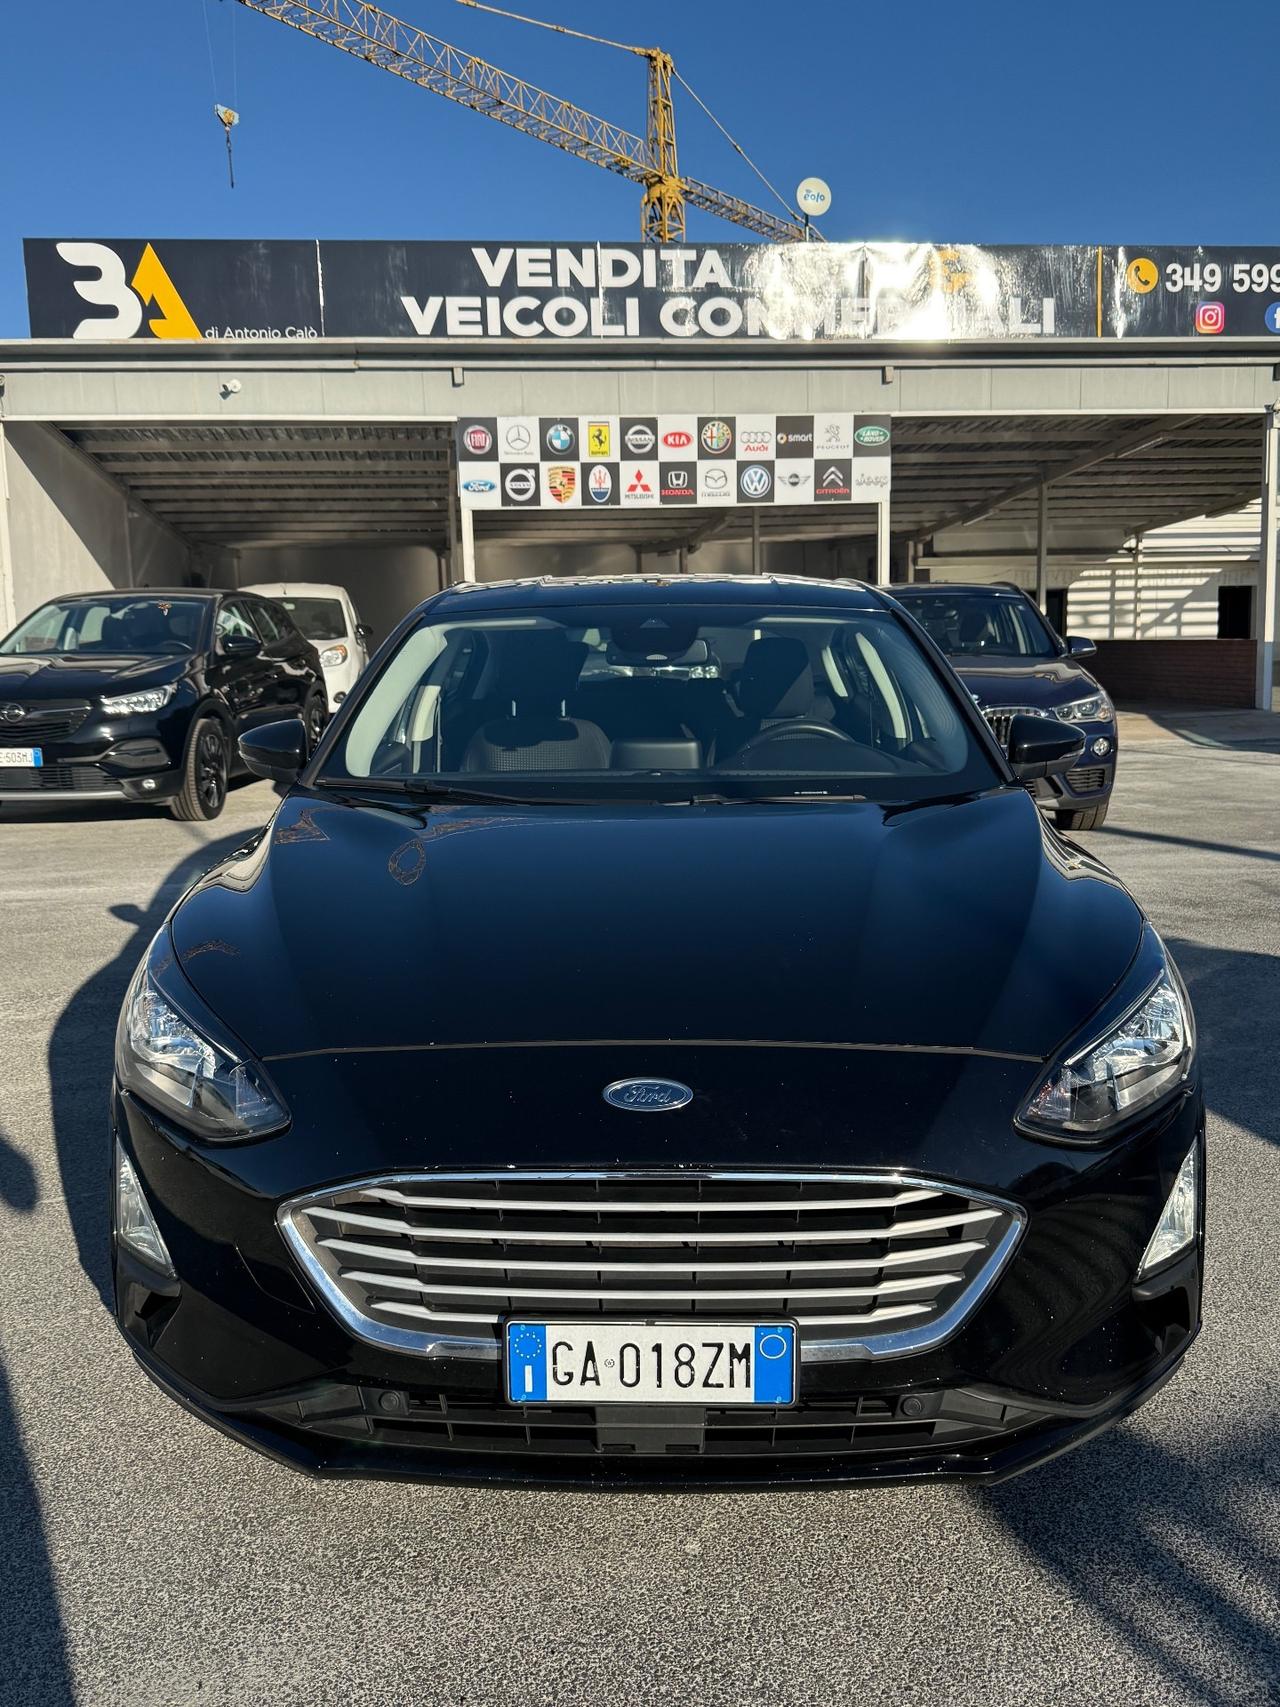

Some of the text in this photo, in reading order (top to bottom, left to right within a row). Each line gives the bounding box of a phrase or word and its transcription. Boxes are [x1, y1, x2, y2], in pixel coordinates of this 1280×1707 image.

[471, 247, 732, 289] VENDITA
[1165, 262, 1222, 293] 349
[401, 295, 640, 337] VEICOLI
[205, 326, 221, 339] di
[223, 327, 282, 339] Antonio
[471, 433, 486, 446] FIAT
[667, 434, 688, 445] KIA
[787, 432, 813, 443] smart
[744, 444, 769, 452] Audi
[468, 478, 490, 491] Ford
[661, 488, 695, 497] HONDA
[624, 1084, 672, 1104] Ford
